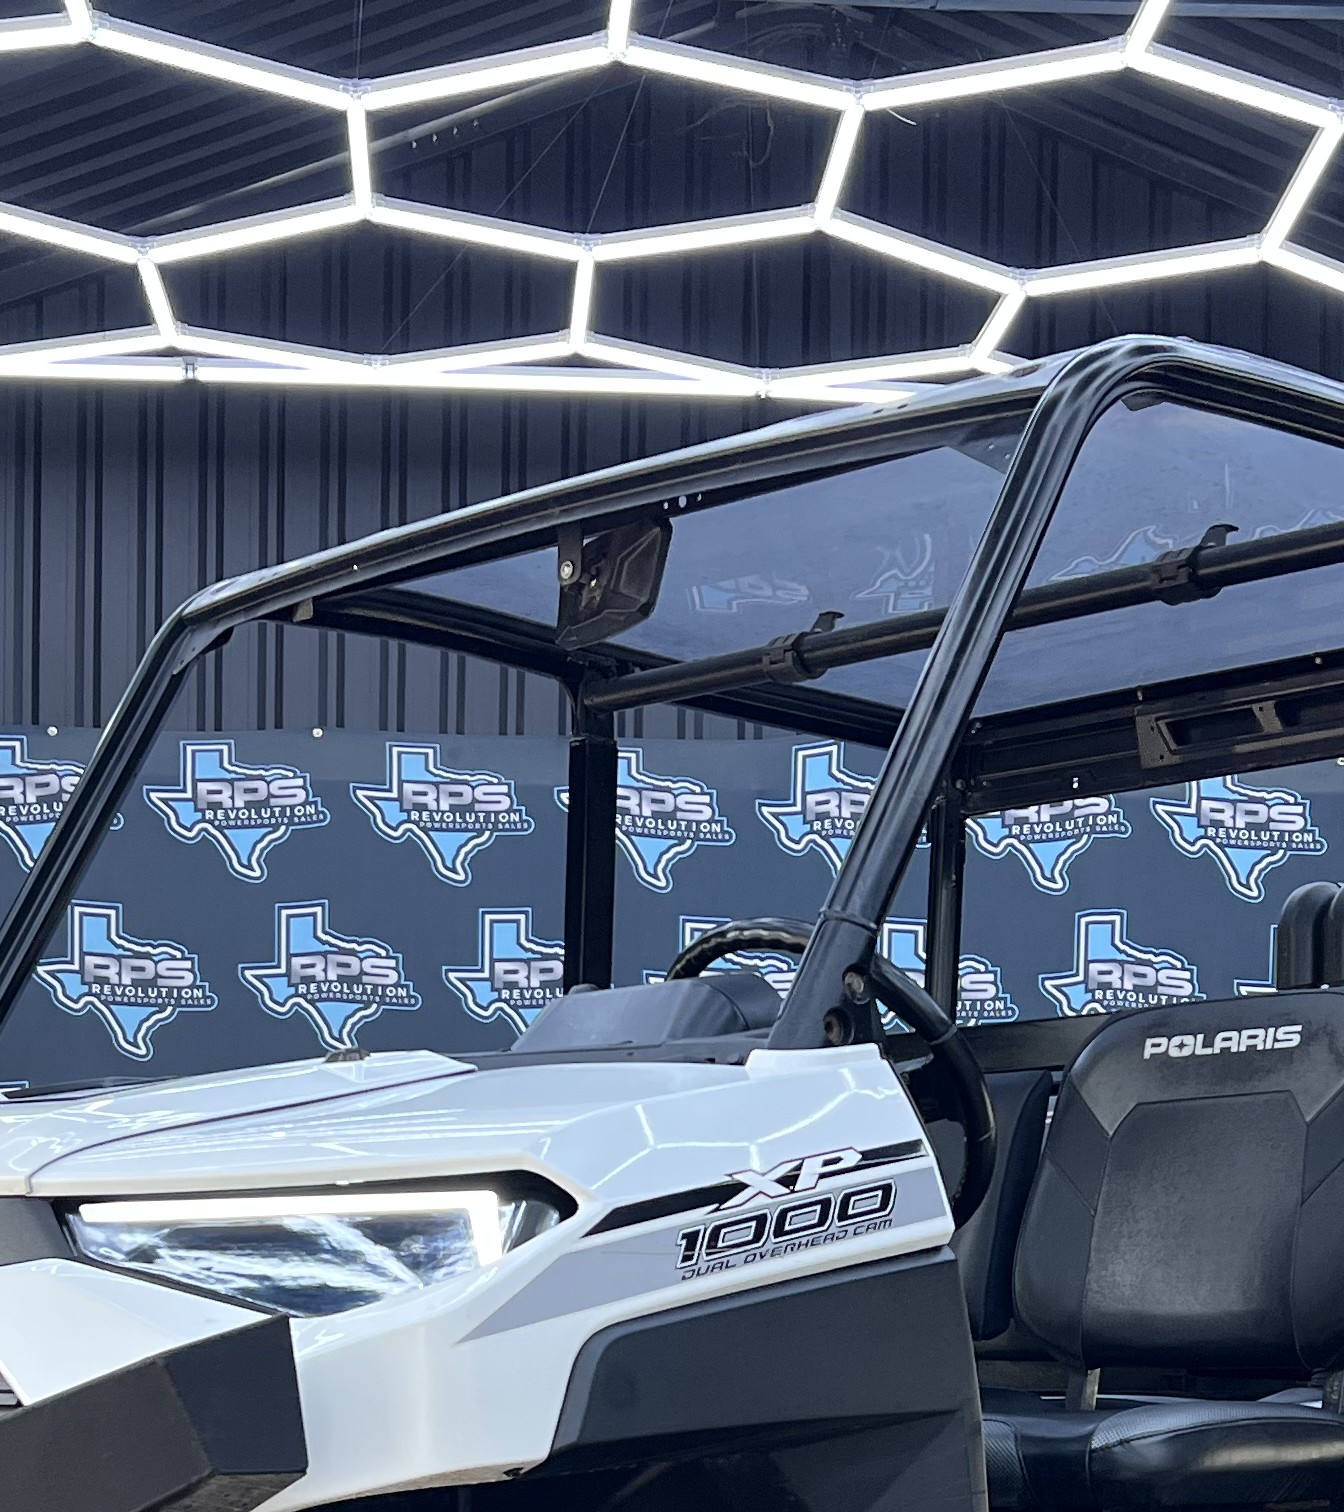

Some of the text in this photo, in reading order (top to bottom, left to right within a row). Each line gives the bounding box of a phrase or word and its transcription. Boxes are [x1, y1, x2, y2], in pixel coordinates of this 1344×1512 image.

[197, 778, 306, 809] RPS
[403, 784, 510, 812] RPS
[806, 791, 872, 821] RP
[205, 804, 316, 820] REVOLUTION
[411, 811, 520, 822] REVOLUTION
[1012, 814, 1118, 836] REVOLUTION
[1201, 800, 1304, 831] RPS
[1208, 827, 1312, 842] REVOLUTION
[84, 956, 194, 986] RPS
[291, 954, 397, 984] RPS
[494, 960, 563, 988] RP
[1088, 962, 1192, 996] RPS
[92, 984, 203, 998] REVOLUTION
[299, 983, 406, 997] REVOLUTION
[501, 988, 563, 1000] REVOLU
[1143, 1024, 1303, 1059] POLARIS
[718, 1146, 862, 1210] XP
[676, 1179, 897, 1269] 1000
[681, 1218, 893, 1281] DUAL OVERHEAD CAM
